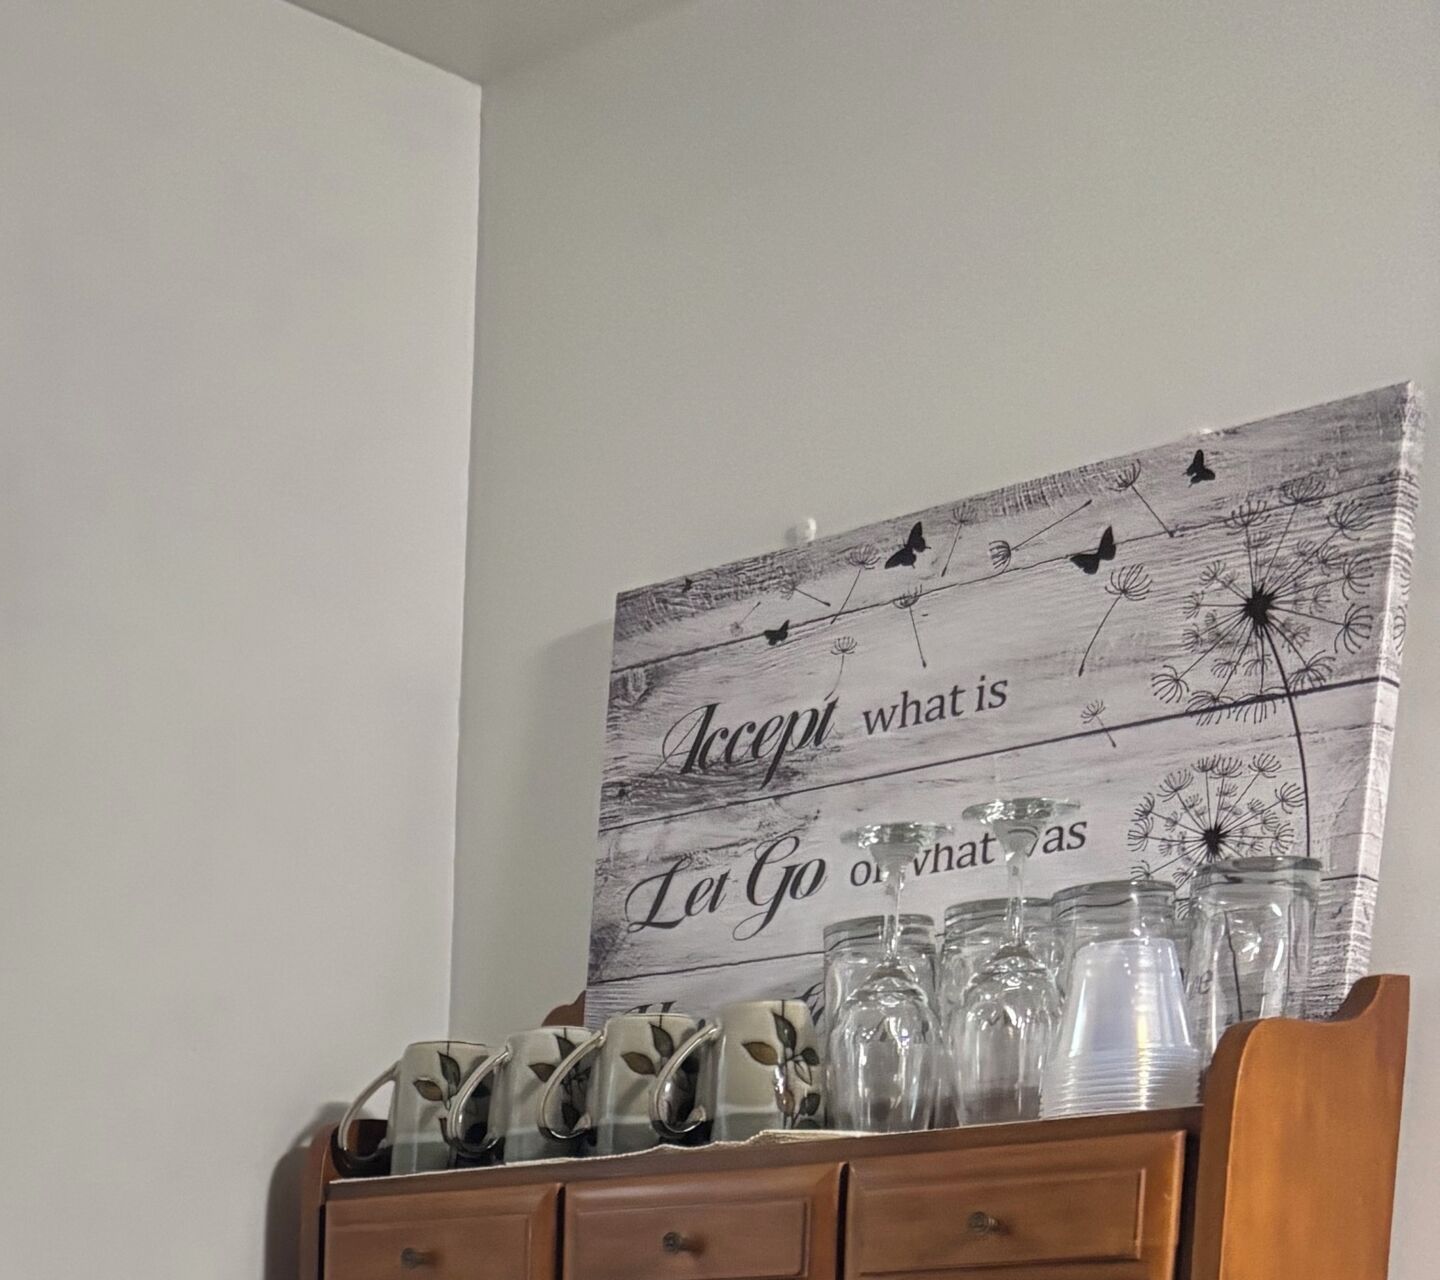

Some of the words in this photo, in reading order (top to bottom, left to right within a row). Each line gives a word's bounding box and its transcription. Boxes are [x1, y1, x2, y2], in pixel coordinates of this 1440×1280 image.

[651, 697, 839, 789] Accept
[862, 684, 966, 735] what
[975, 675, 1008, 711] is
[625, 856, 729, 933] Let
[732, 835, 826, 941] Go
